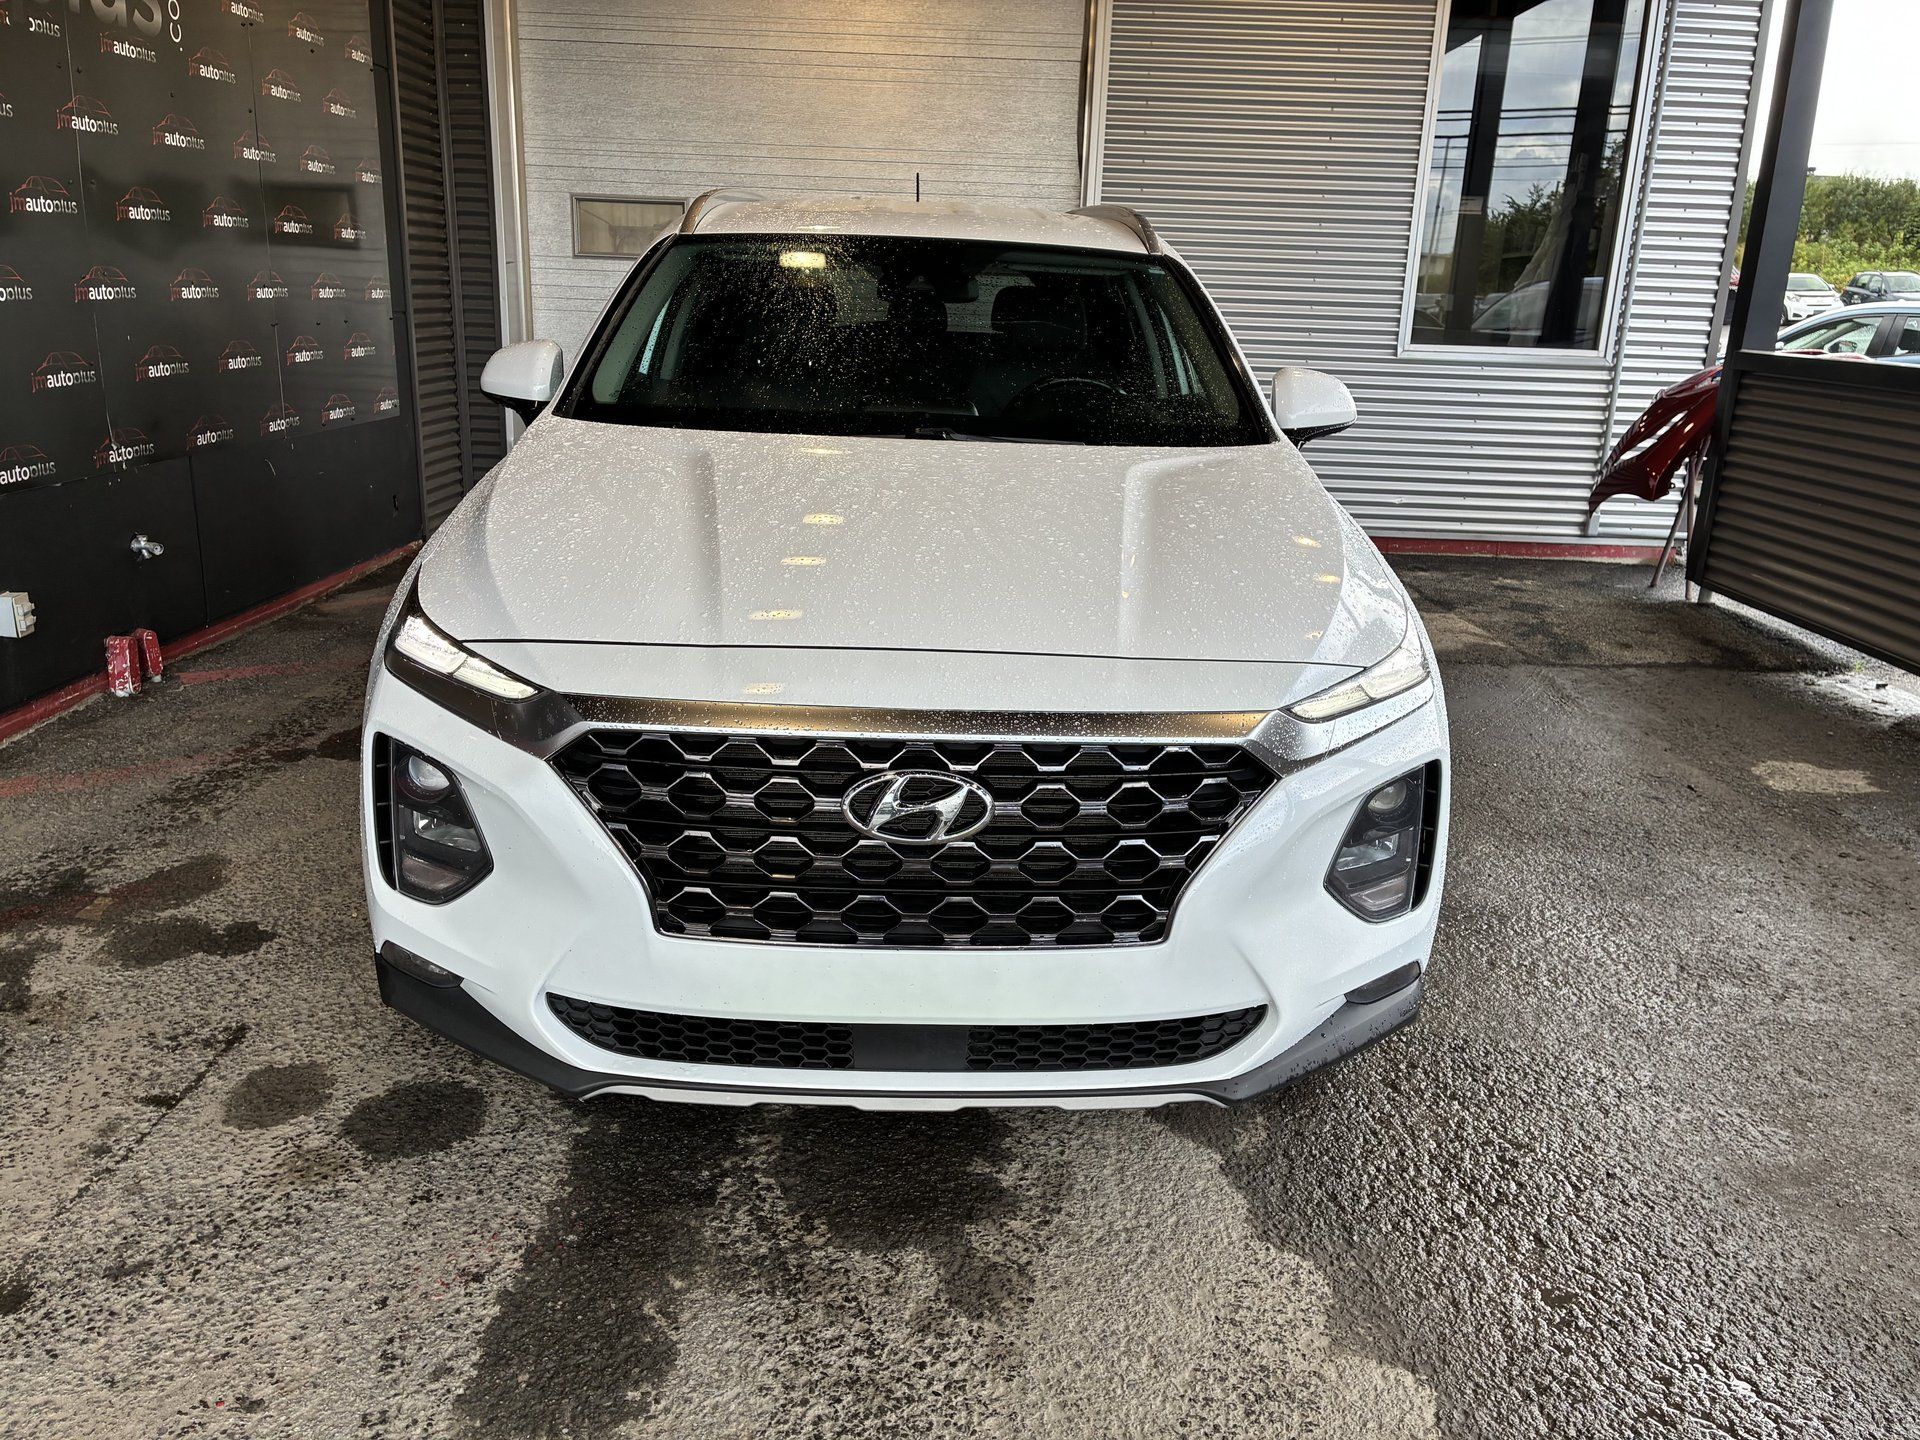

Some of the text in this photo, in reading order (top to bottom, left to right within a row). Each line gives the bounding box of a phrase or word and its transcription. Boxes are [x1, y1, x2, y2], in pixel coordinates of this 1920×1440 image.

[288, 21, 325, 47] jmautoplus
[100, 33, 157, 63] jmautoplus
[188, 58, 236, 84] jmautoplus
[262, 79, 301, 102] jmautoplus
[57, 109, 119, 136] jmautoplus
[152, 127, 205, 150] jmautoplus
[234, 142, 276, 162] jmautoplus
[300, 156, 336, 175] jmautoplus
[9, 192, 78, 214] jmautoplus
[115, 202, 171, 222] jmautoplus
[203, 210, 249, 229] jmautoplus
[274, 218, 313, 235] jmautoplus
[334, 223, 366, 240] jmautoplus
[74, 283, 137, 303] jmautoplus
[170, 284, 219, 301] jmautoplus
[247, 284, 288, 301] jmautoplus
[311, 285, 346, 301] jmautoplus
[287, 349, 324, 366] jmautoplus
[344, 345, 376, 360] jmautoplus
[135, 362, 190, 382] jmautoplus
[218, 355, 262, 374] jmautoplus
[31, 370, 96, 393] jmautoplus
[321, 405, 355, 423] jmautoplus
[260, 415, 300, 436] jmautoplus
[186, 427, 234, 451] jmautoplus
[95, 442, 155, 469] jmautoplus
